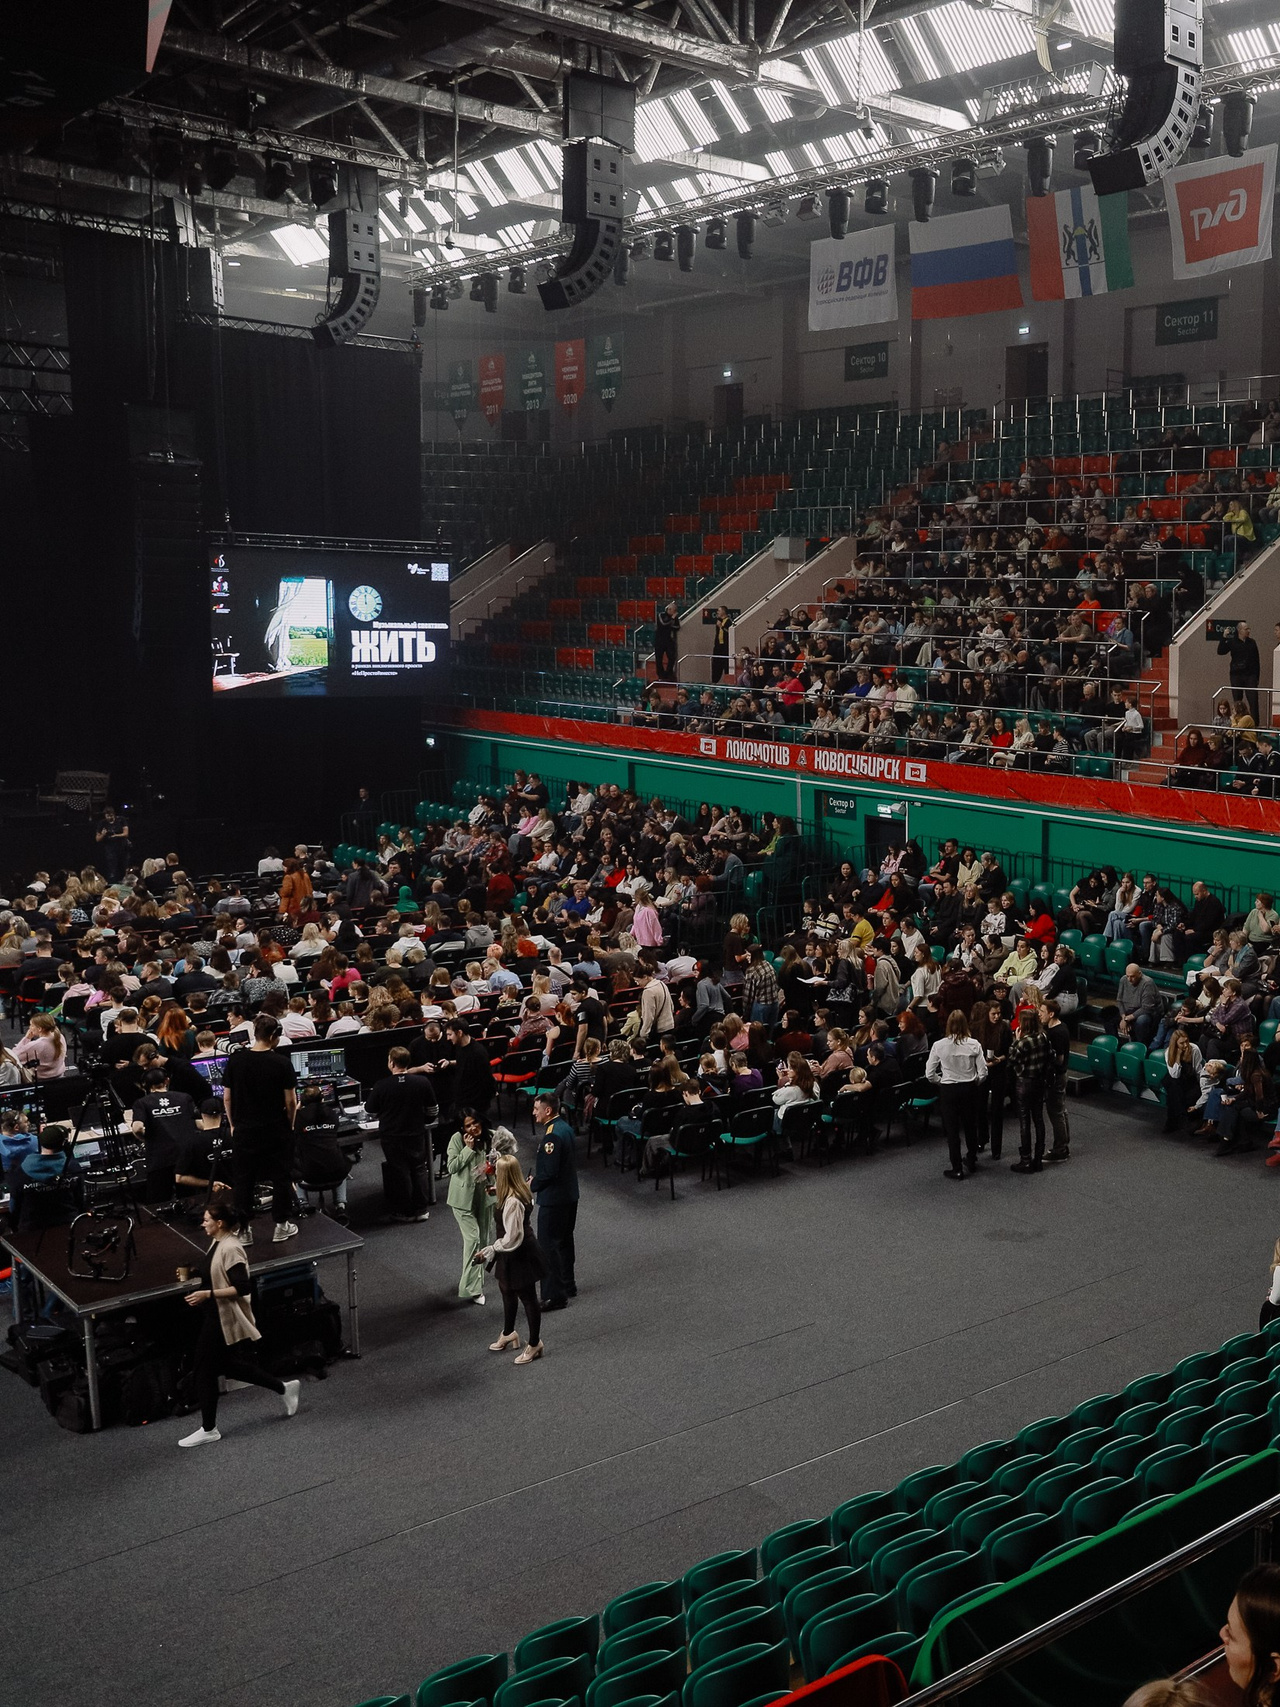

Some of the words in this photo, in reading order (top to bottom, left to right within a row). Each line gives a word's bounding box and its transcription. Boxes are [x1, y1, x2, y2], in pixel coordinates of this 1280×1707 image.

[835, 254, 889, 293] ВФВ
[1164, 314, 1200, 327] Сектор
[1203, 309, 1214, 323] 11
[1177, 327, 1199, 336] Sector
[850, 355, 876, 366] Сектор
[877, 351, 886, 363] 10
[563, 393, 578, 405] 2020
[601, 387, 616, 400] 2025
[486, 404, 499, 415] 2011
[525, 399, 540, 410] 2013
[1215, 624, 1236, 634] Сеор
[350, 630, 436, 663] ЖИТЬ
[726, 739, 790, 766] ЛОКОМОТИВ
[814, 749, 901, 780] НОВОСИБИРСК
[828, 797, 848, 809] Сектор
[151, 1105, 181, 1116] CAST
